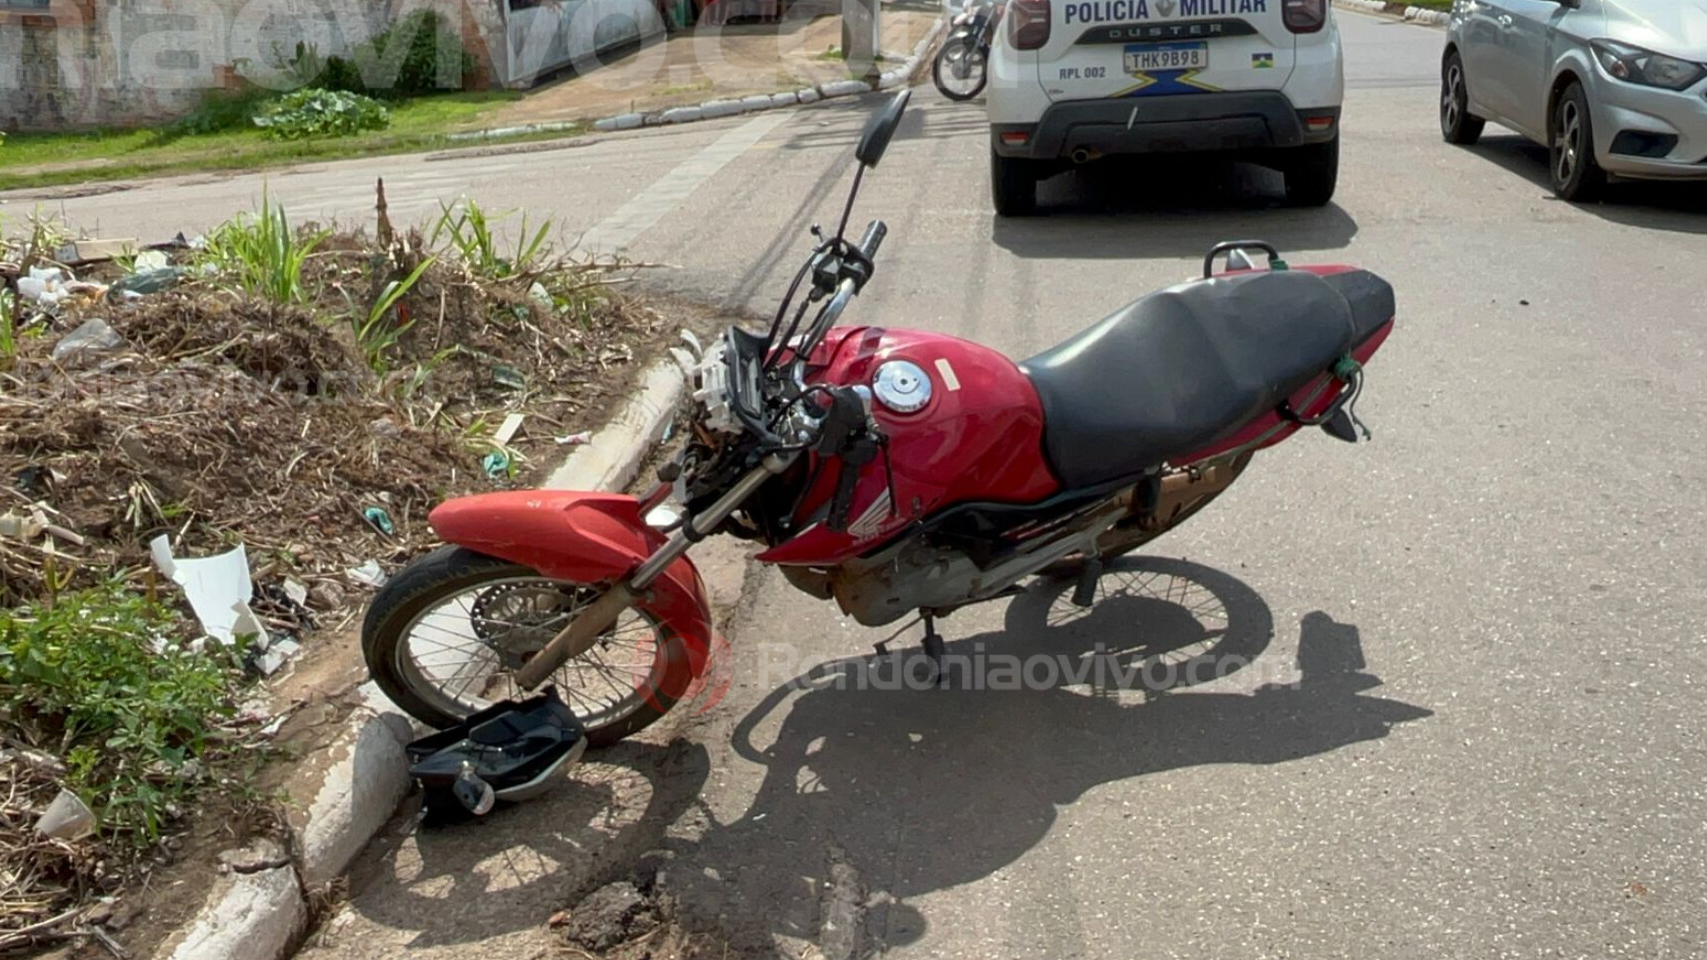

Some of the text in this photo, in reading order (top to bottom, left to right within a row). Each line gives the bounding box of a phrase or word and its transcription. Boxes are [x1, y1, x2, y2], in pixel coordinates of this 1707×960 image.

[1109, 23, 1222, 38] DUSTER
[1132, 50, 1199, 68] THK9B98
[1059, 66, 1106, 80] RPL 002
